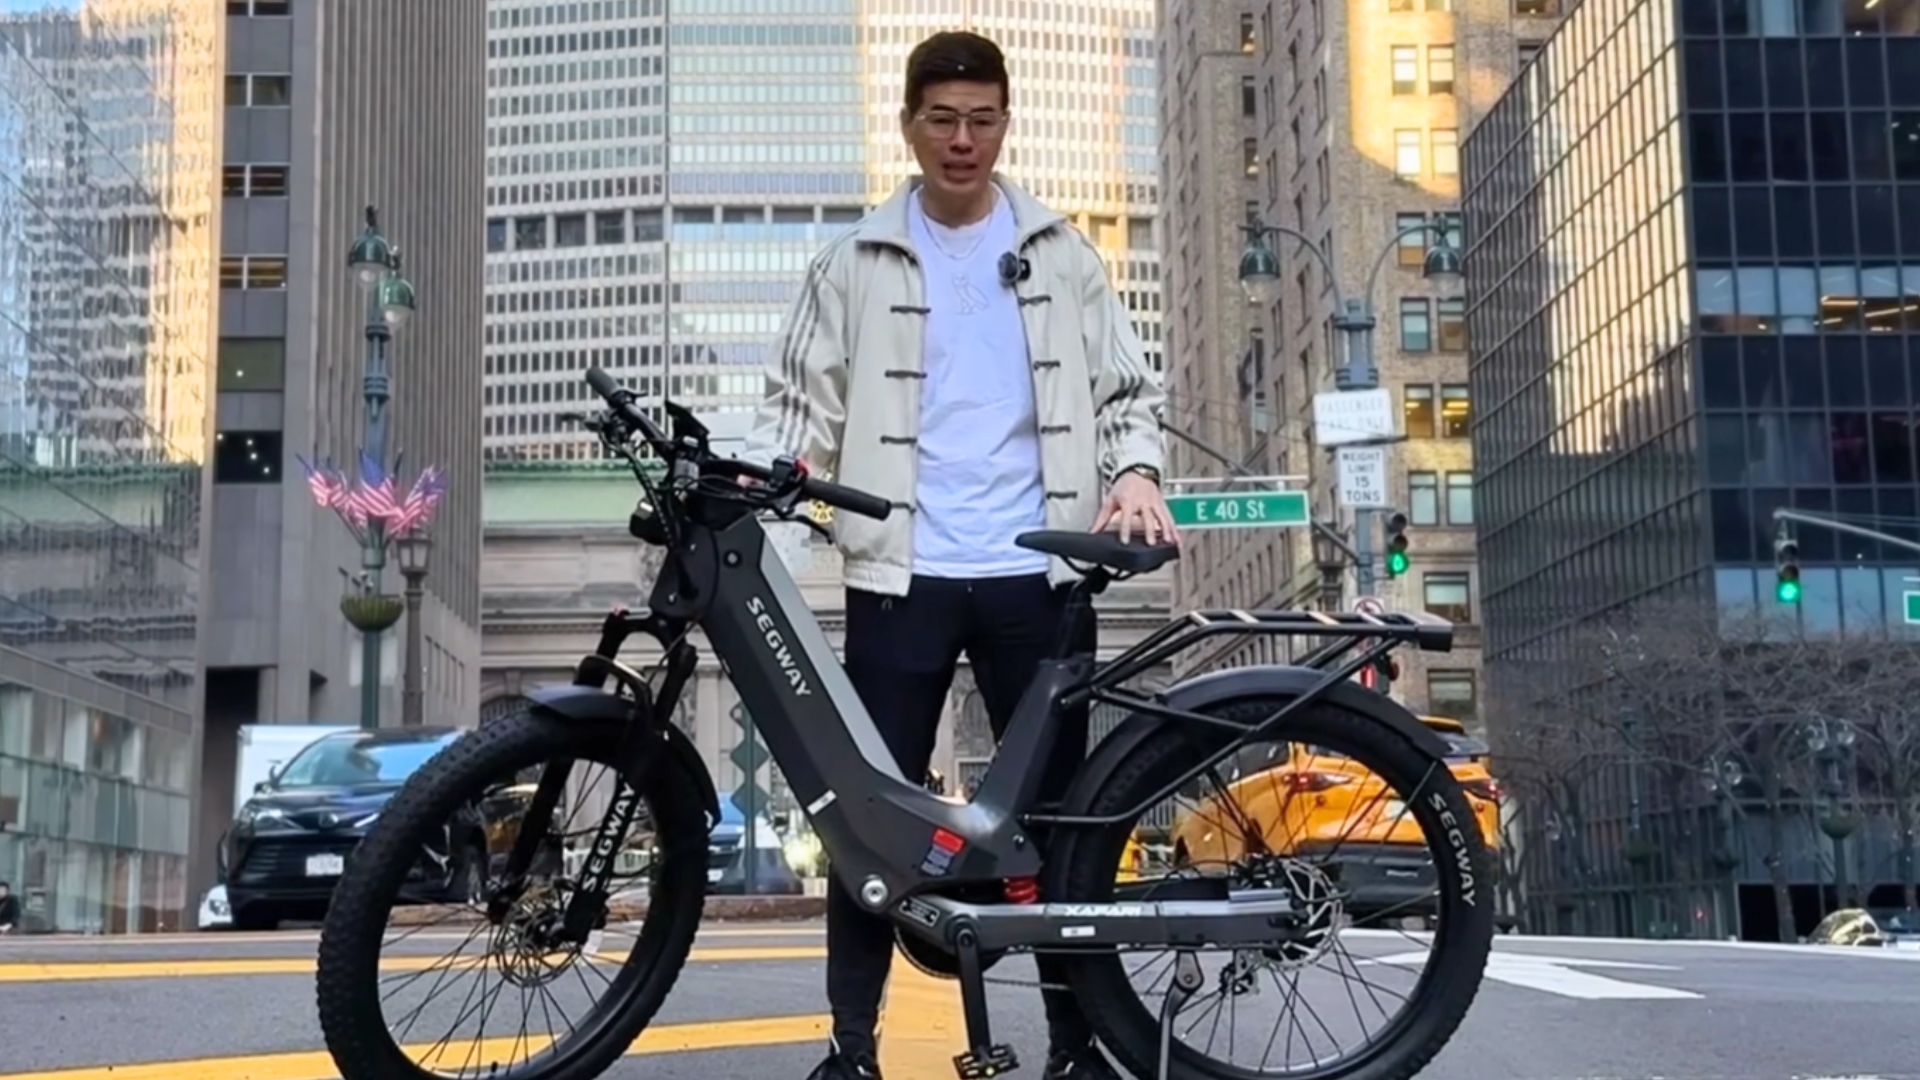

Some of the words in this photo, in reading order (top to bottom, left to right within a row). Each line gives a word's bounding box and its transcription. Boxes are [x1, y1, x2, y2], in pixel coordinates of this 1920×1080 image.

[1320, 398, 1384, 413] PASSENGER
[1342, 451, 1380, 462] WEIGHT
[1348, 464, 1375, 473] LIMIT
[1355, 477, 1370, 487] 15
[1345, 491, 1381, 503] TONS
[1196, 501, 1209, 521] E
[1215, 499, 1239, 520] 40
[1246, 499, 1266, 519] St
[746, 595, 812, 697] SEGWAY
[582, 781, 636, 893] SEGWAY
[1428, 792, 1476, 908] SEGWAY
